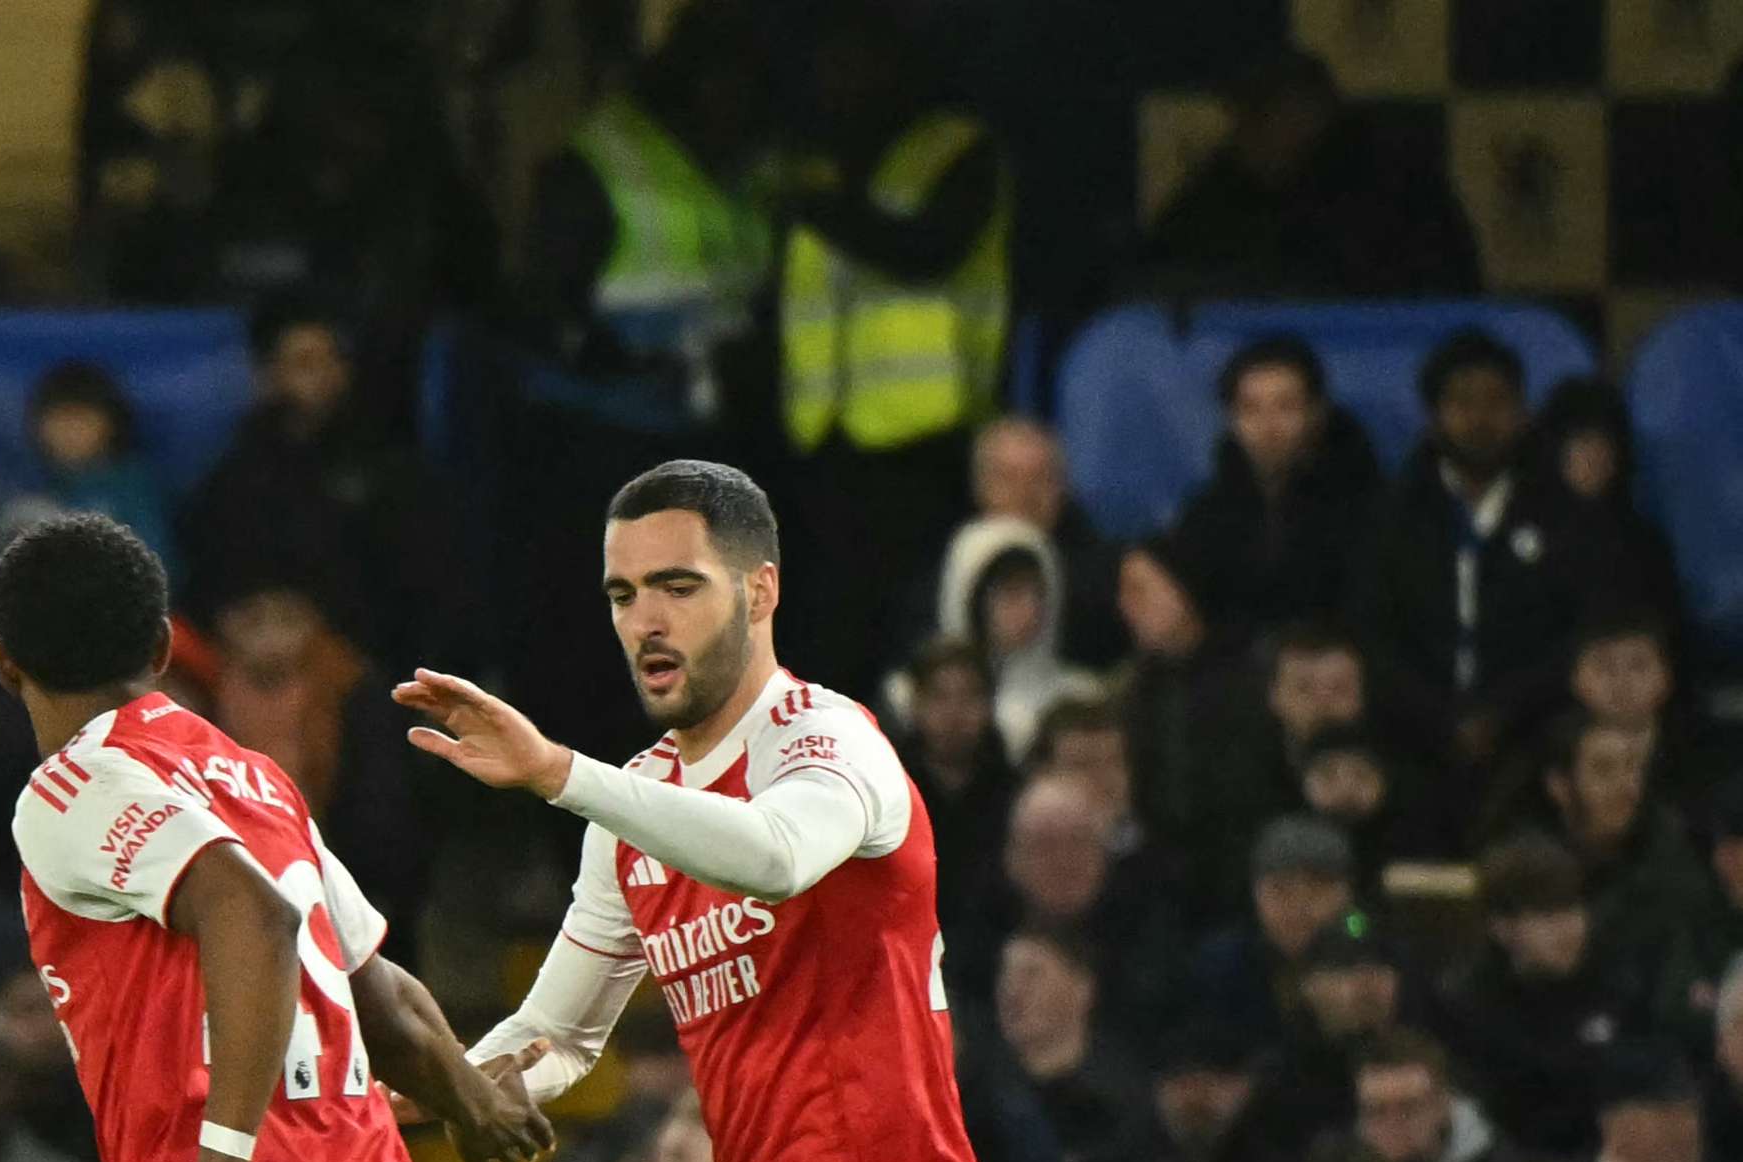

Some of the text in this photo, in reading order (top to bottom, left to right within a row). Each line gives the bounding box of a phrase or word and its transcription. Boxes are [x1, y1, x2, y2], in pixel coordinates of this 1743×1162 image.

[779, 735, 838, 755] VISIT
[100, 802, 145, 853] VISIT
[110, 803, 184, 890] RWANDA
[636, 896, 776, 978] mirates
